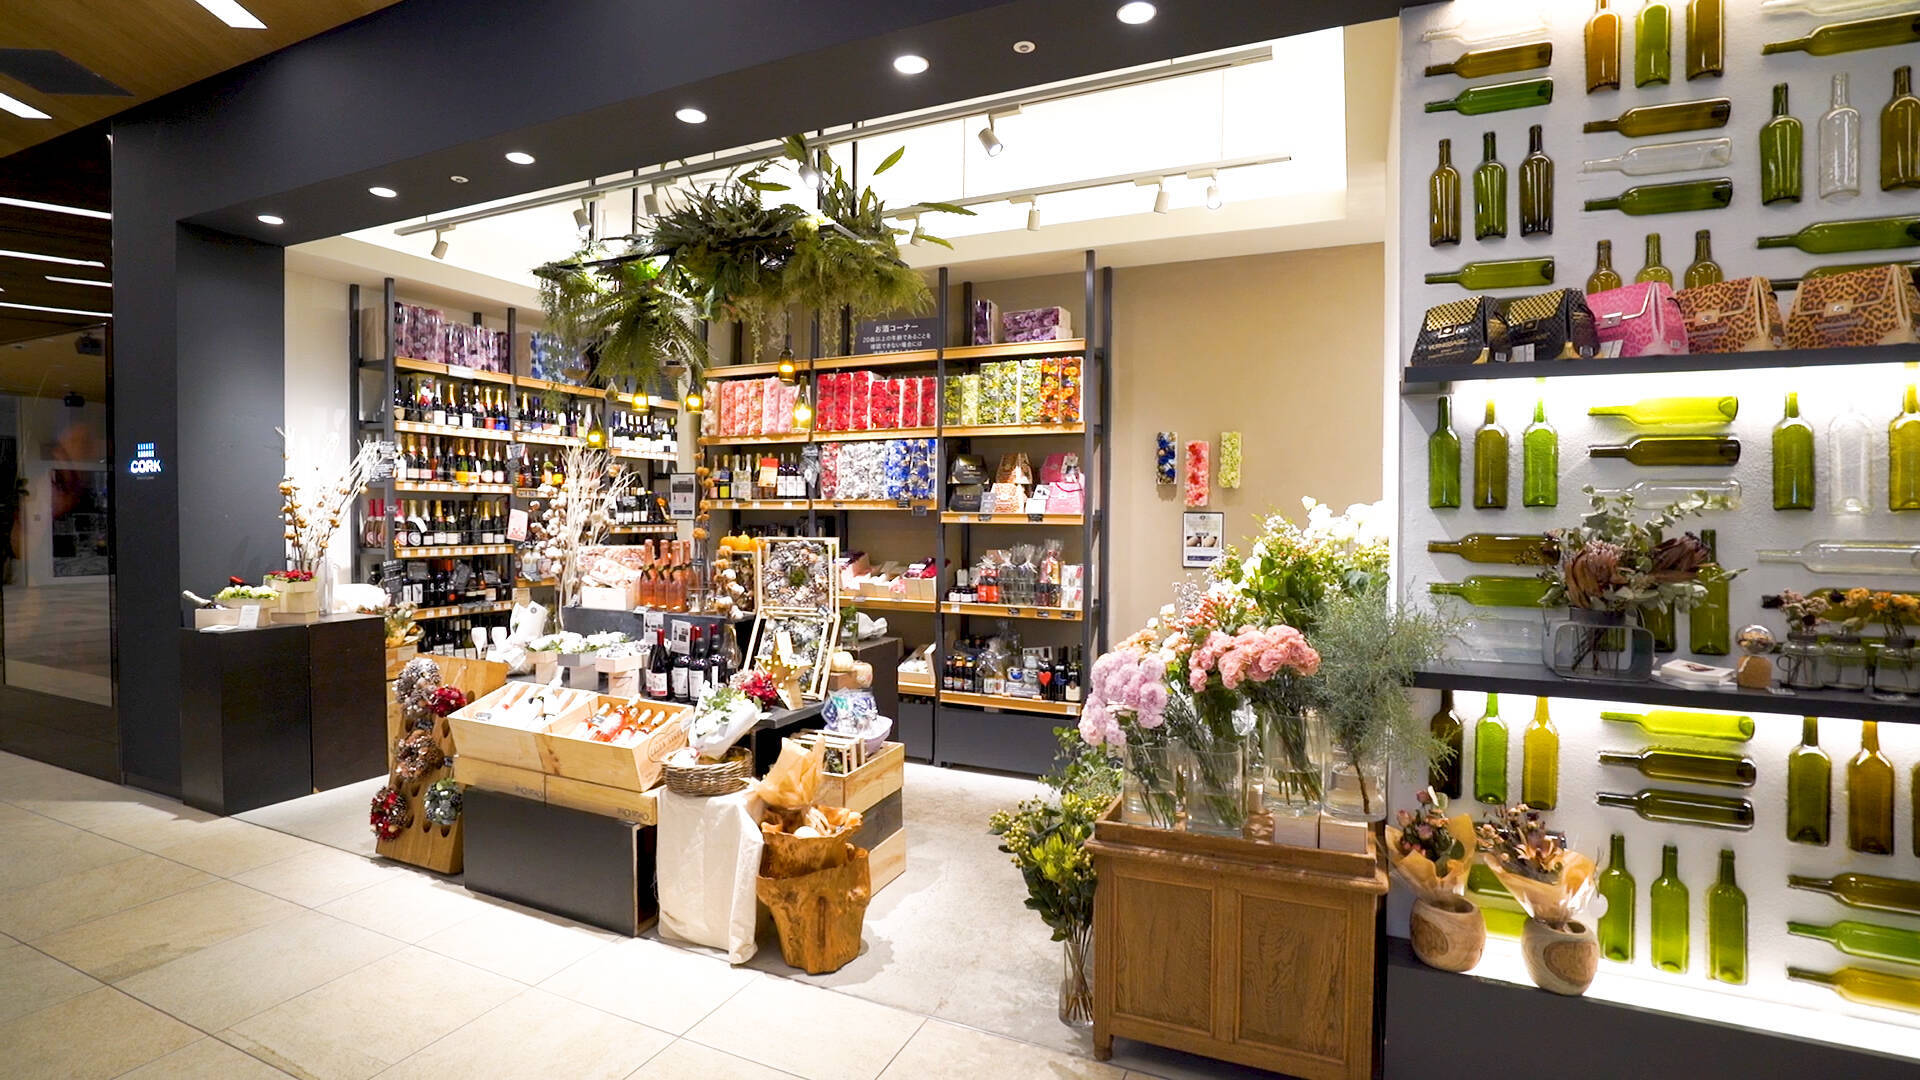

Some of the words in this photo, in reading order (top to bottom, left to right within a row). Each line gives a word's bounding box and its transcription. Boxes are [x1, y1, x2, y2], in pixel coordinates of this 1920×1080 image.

[875, 323, 919, 333] お酒コーナー
[130, 459, 162, 474] CORK
